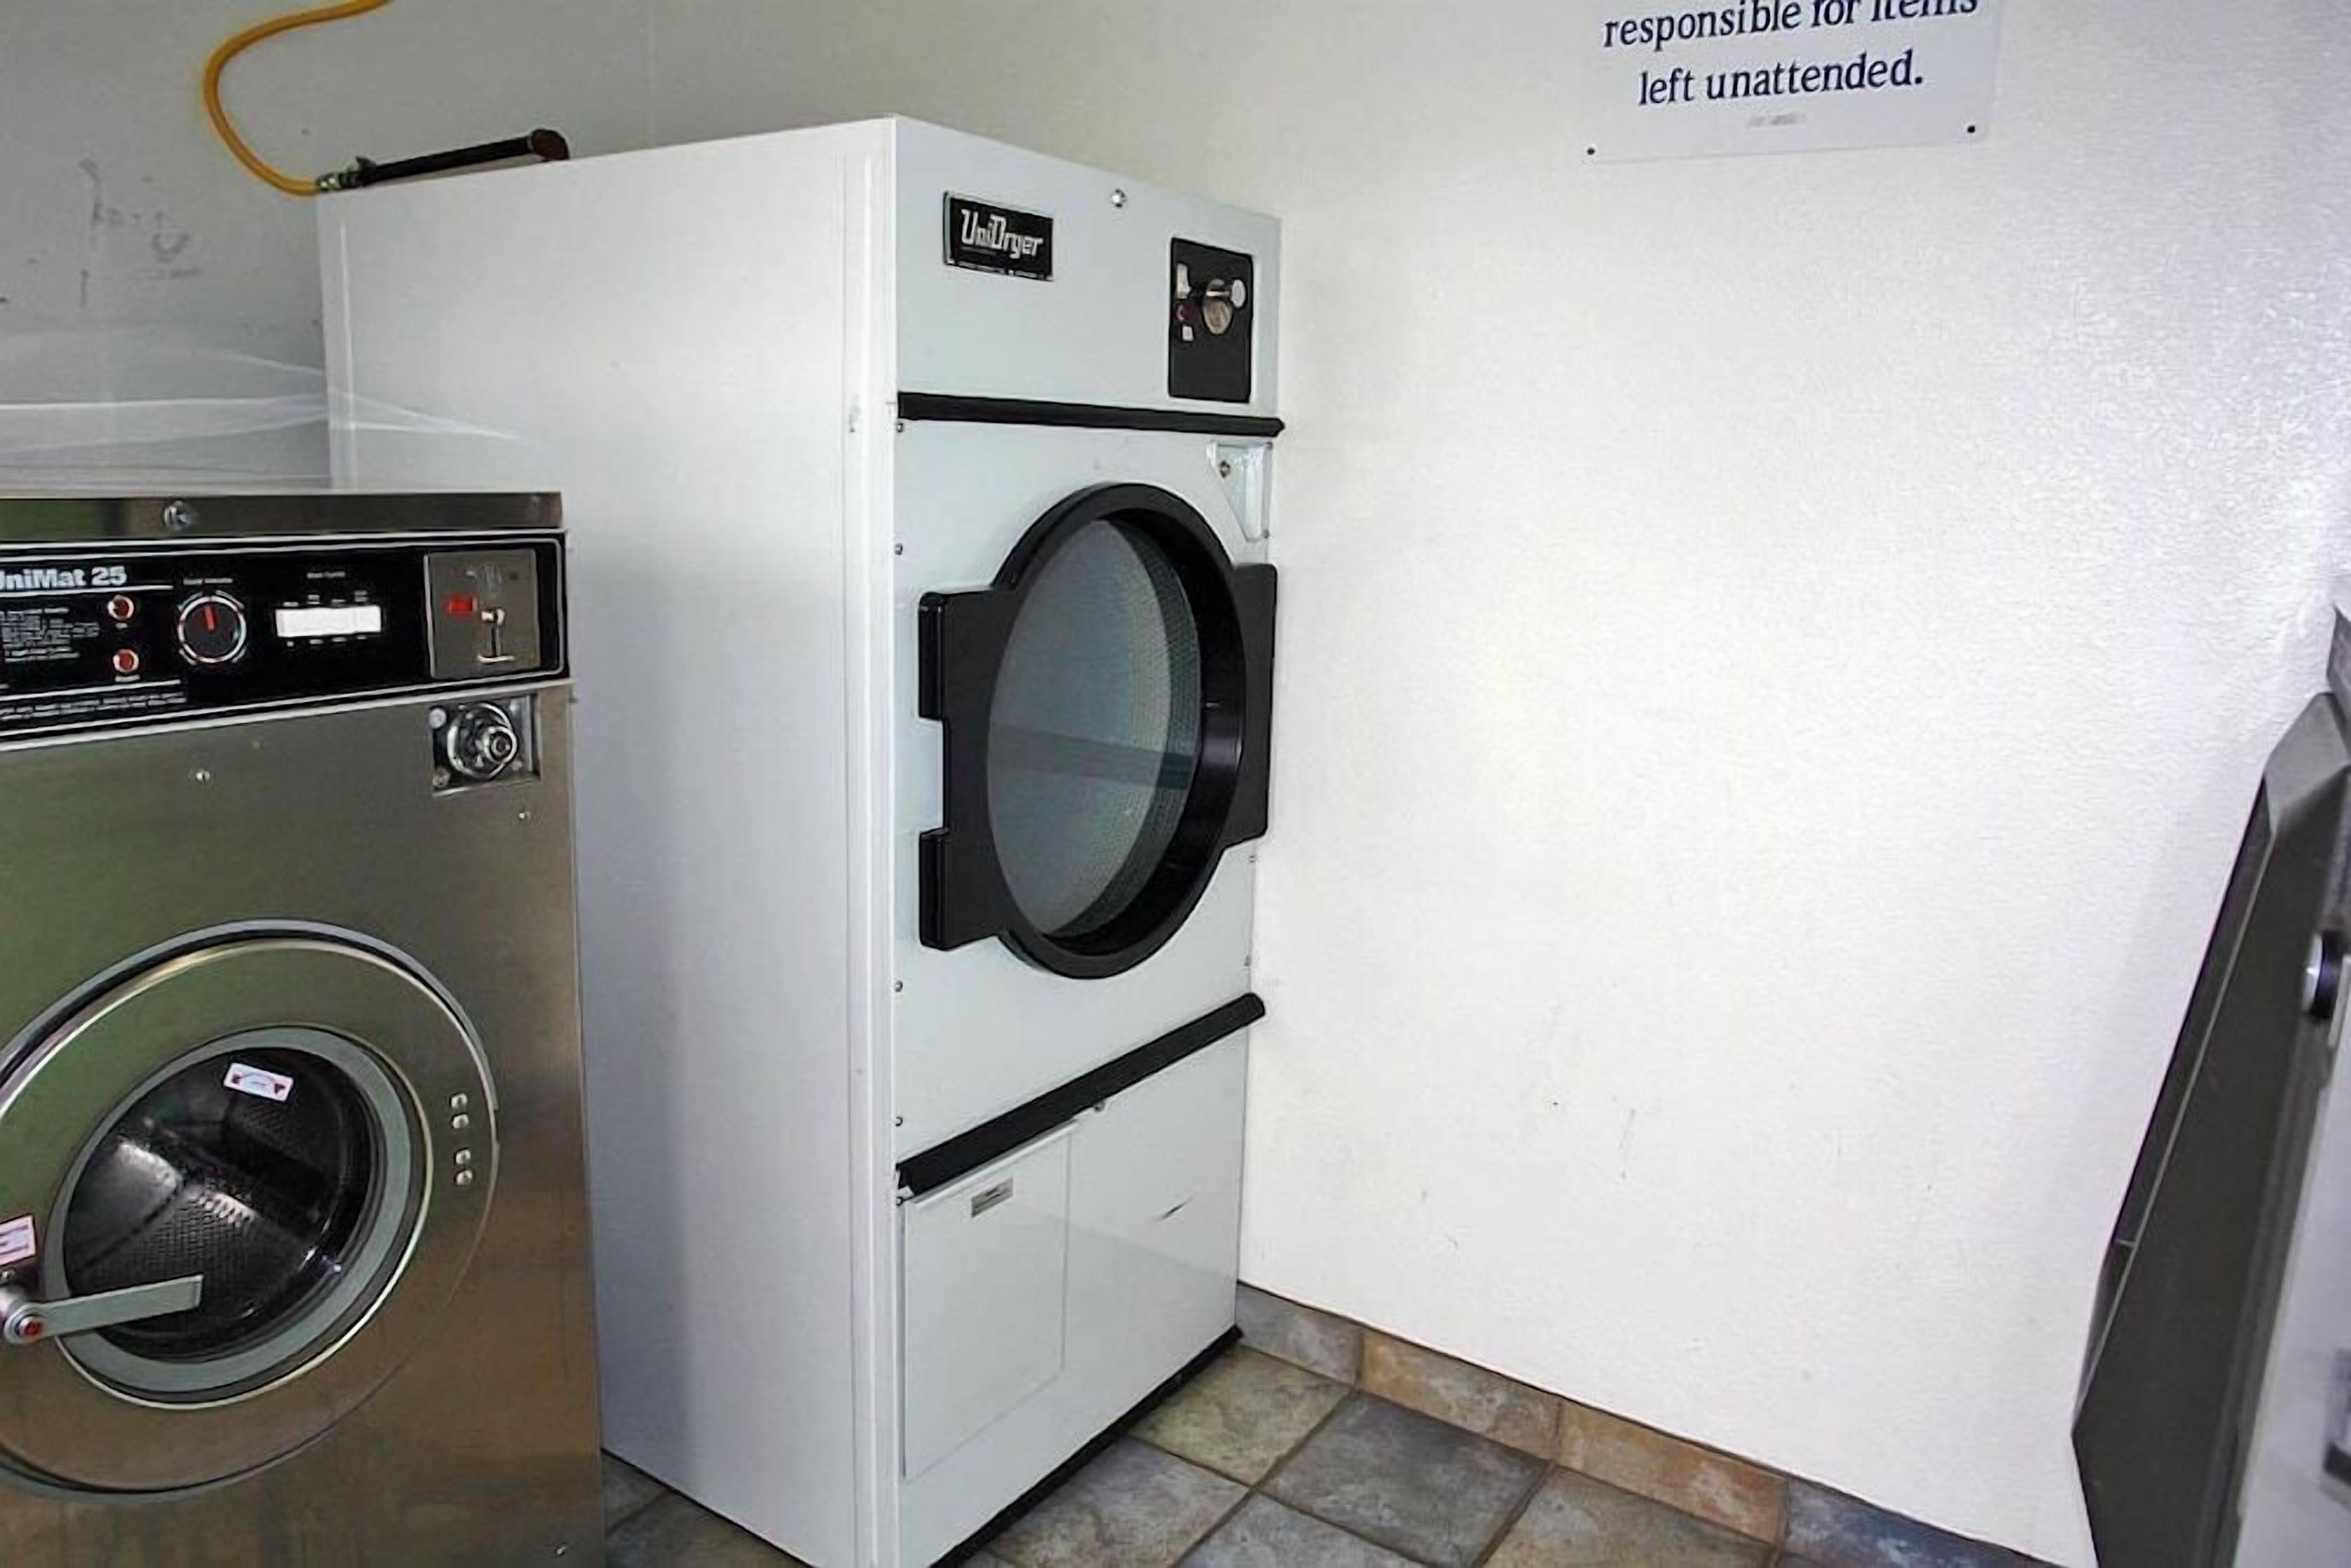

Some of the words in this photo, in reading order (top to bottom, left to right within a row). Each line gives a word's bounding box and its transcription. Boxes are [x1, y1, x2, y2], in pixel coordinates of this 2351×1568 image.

[1603, 0, 1802, 52] responsible
[1638, 69, 1694, 106] left
[1706, 49, 1924, 99] unattended.
[961, 208, 1044, 259] UniDryer
[91, 565, 127, 586] 25
